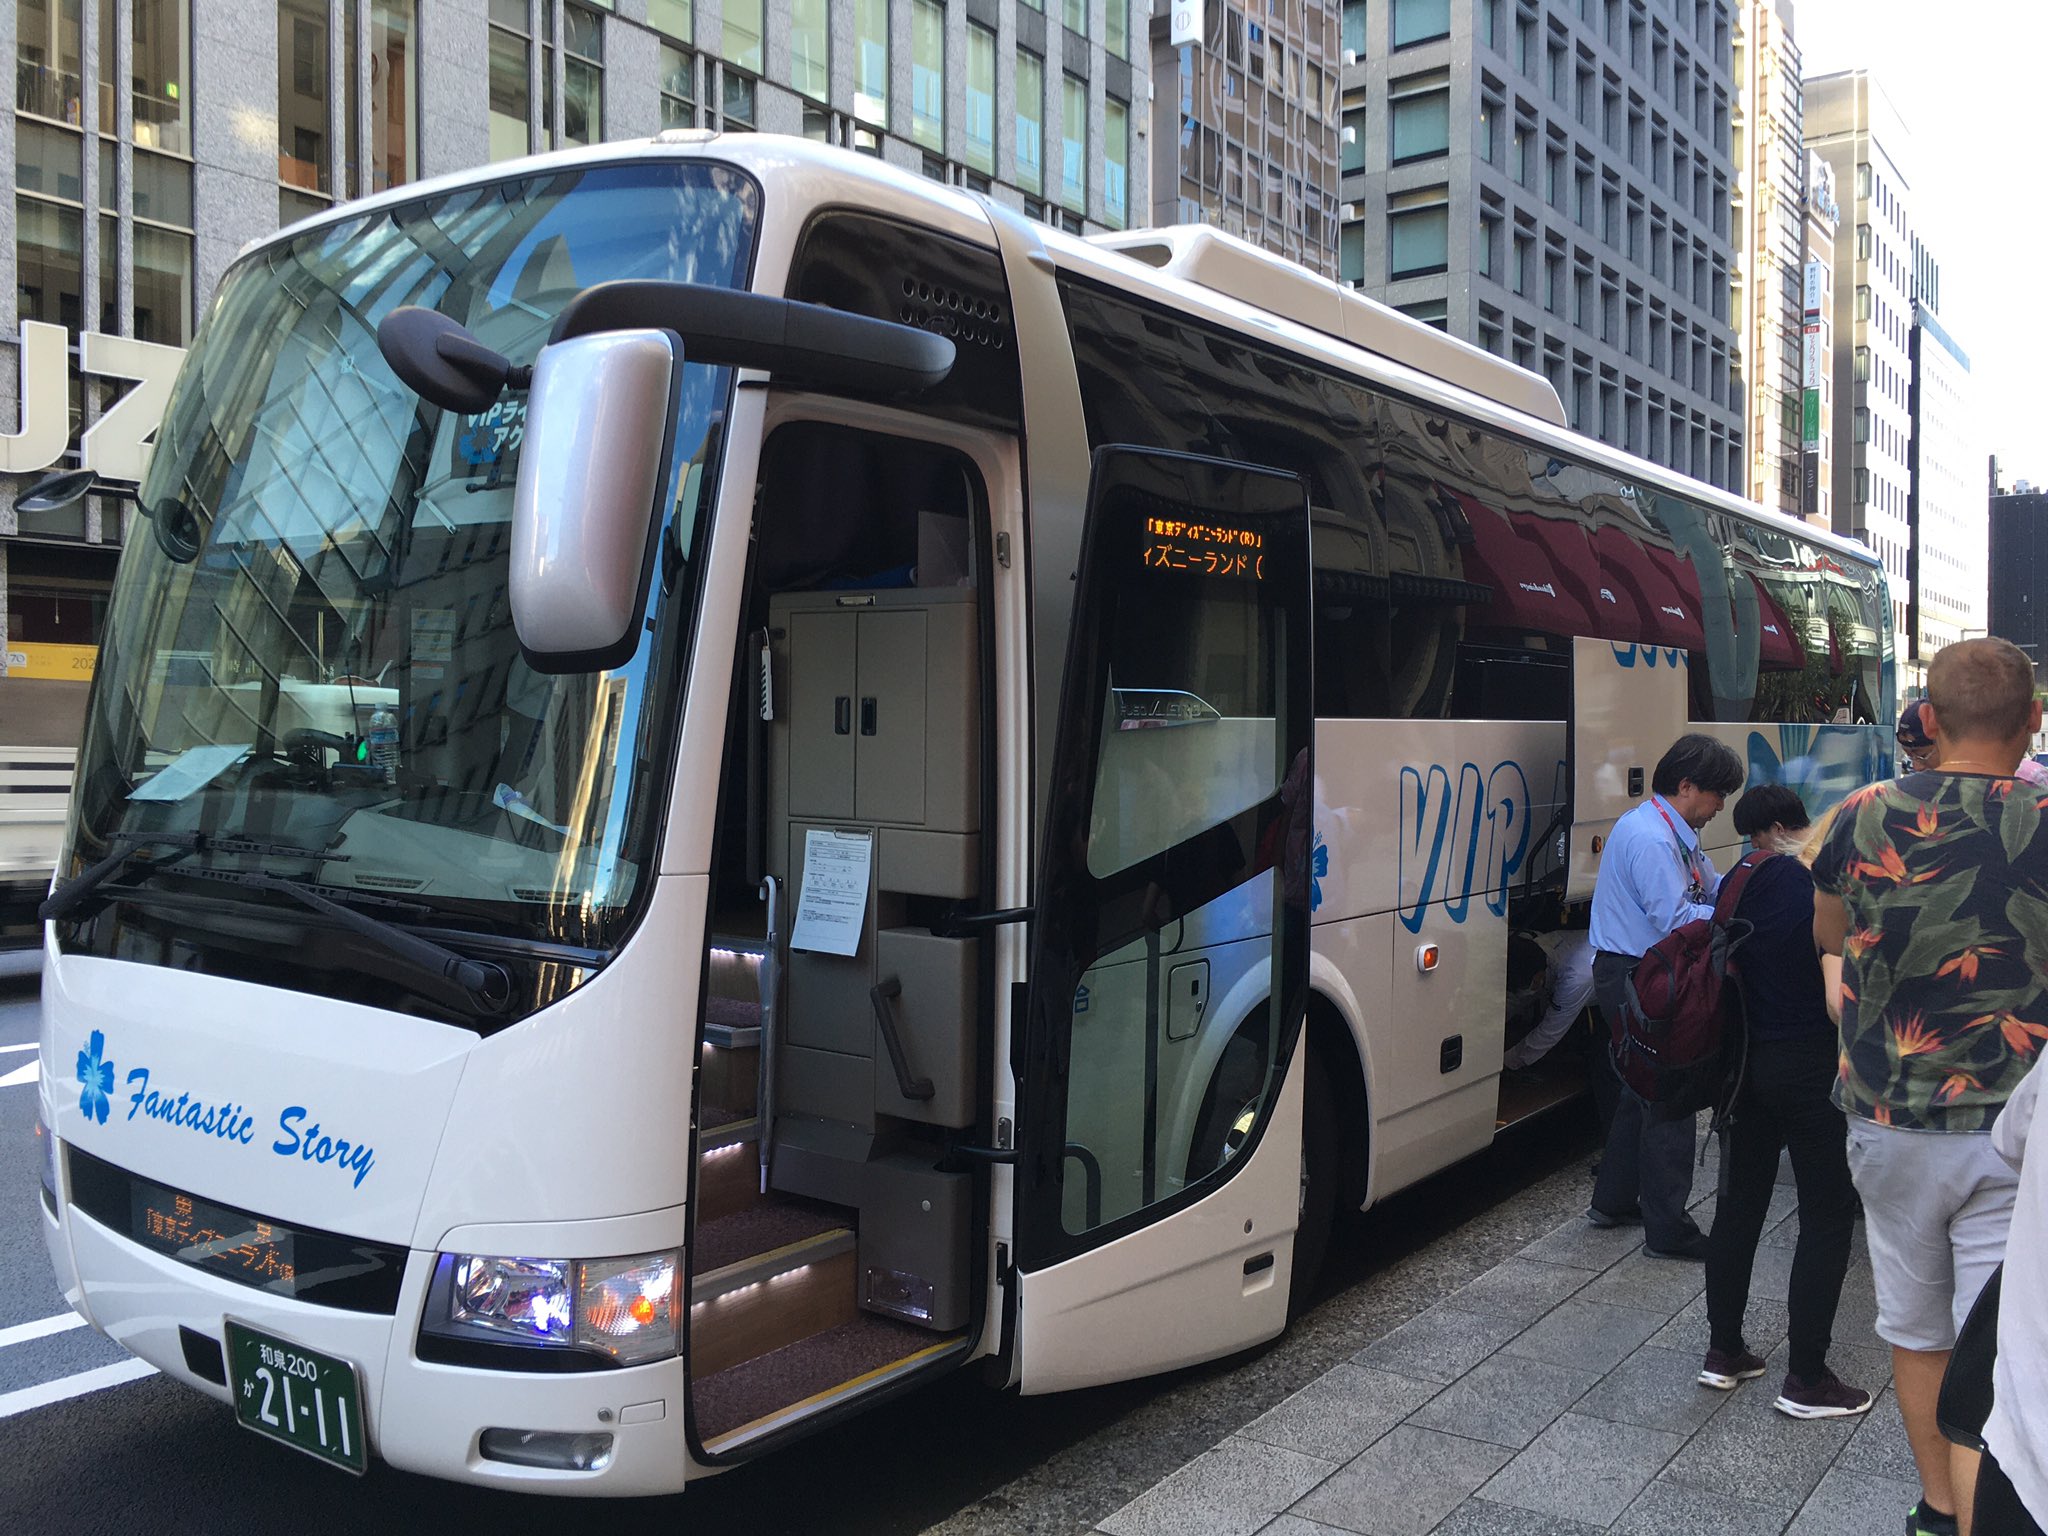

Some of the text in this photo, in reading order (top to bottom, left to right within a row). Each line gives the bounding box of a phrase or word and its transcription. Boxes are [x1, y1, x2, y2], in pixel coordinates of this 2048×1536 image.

[1398, 760, 1531, 934] VIP
[126, 1067, 376, 1190] Fantastic Story
[243, 1367, 351, 1456] か 21-11
